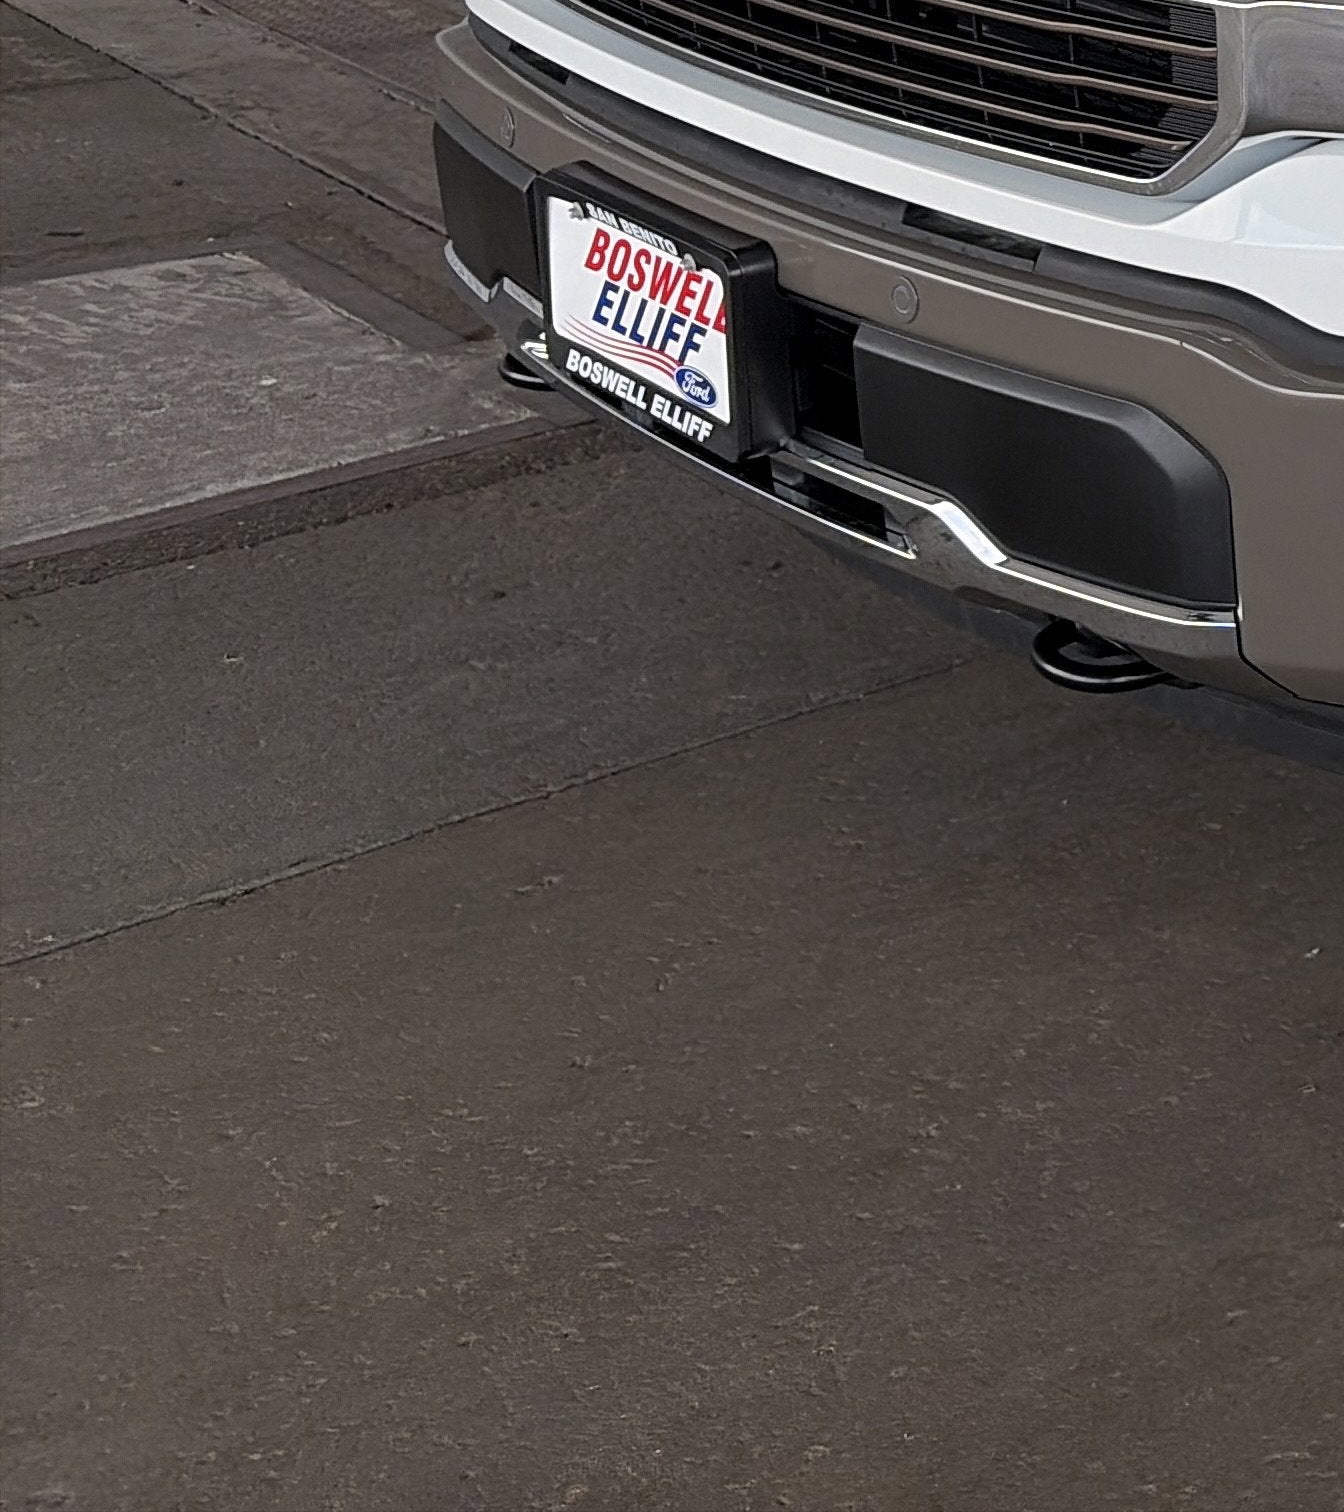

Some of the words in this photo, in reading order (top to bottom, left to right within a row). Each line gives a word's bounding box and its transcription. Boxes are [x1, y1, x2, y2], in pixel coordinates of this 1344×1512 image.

[585, 201, 620, 229] SAN
[618, 217, 679, 256] BENITO
[592, 279, 708, 365] ELLIFF
[565, 348, 648, 410] BOSWELL
[649, 393, 714, 443] ELLIFF
[681, 371, 711, 402] Ford
